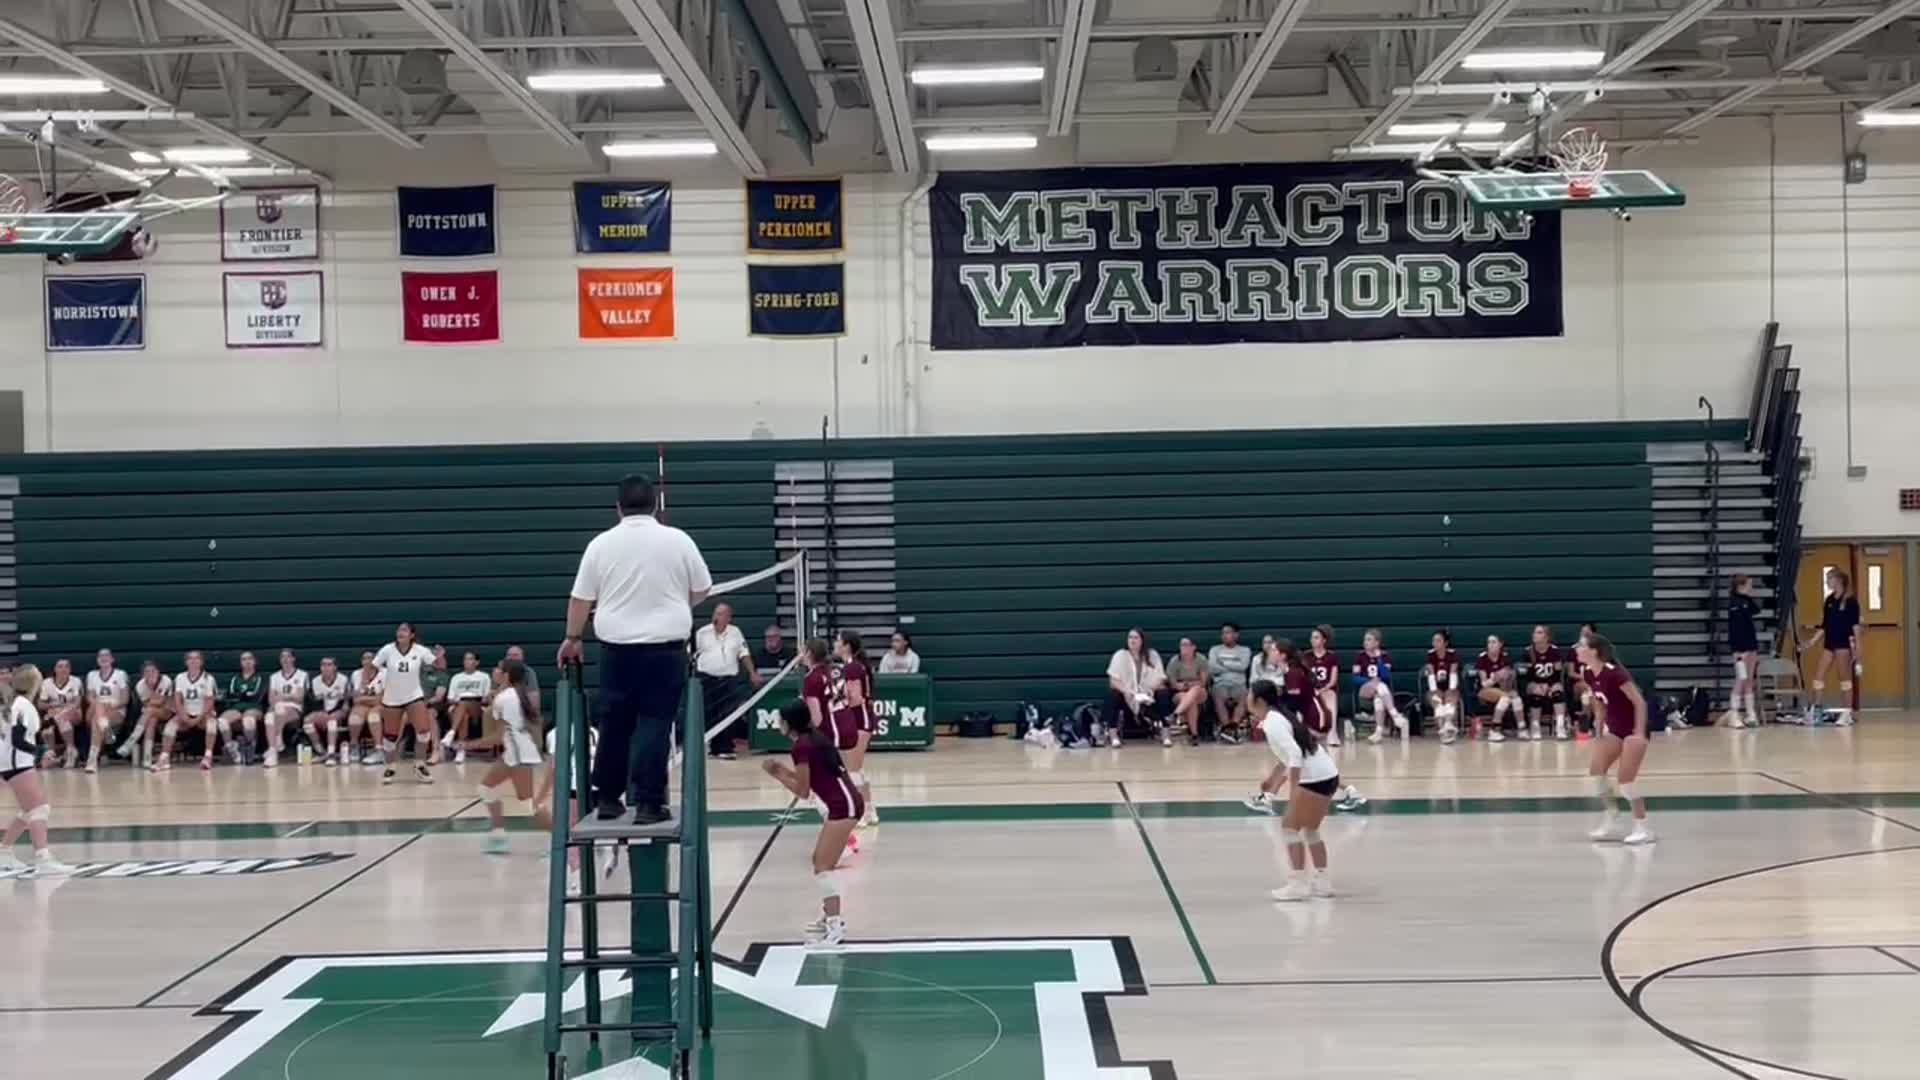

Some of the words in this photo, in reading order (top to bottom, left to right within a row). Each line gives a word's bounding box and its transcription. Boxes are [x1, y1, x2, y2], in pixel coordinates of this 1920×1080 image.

[601, 194, 644, 210] UPPER
[774, 194, 816, 211] UPPER
[407, 212, 488, 230] POTTSTOWN
[961, 178, 1531, 255] METHACTON
[239, 228, 303, 243] FRONTIER
[599, 223, 649, 239] MERION
[758, 221, 832, 238] PERKIOMEN
[420, 286, 457, 302] OWEN
[467, 285, 481, 302] J.
[588, 281, 663, 298] PERKIOMEN
[959, 252, 1530, 327] WARRIORS
[754, 291, 840, 309] SPRING-FORD
[53, 303, 140, 321] NORRISTOWN
[421, 312, 481, 329] ROBERTS
[600, 308, 652, 325] VALLEY
[246, 315, 301, 329] LIBERTY
[398, 661, 410, 673] 21
[1534, 662, 1555, 678] 20
[756, 708, 782, 730] M
[899, 706, 927, 728] M
